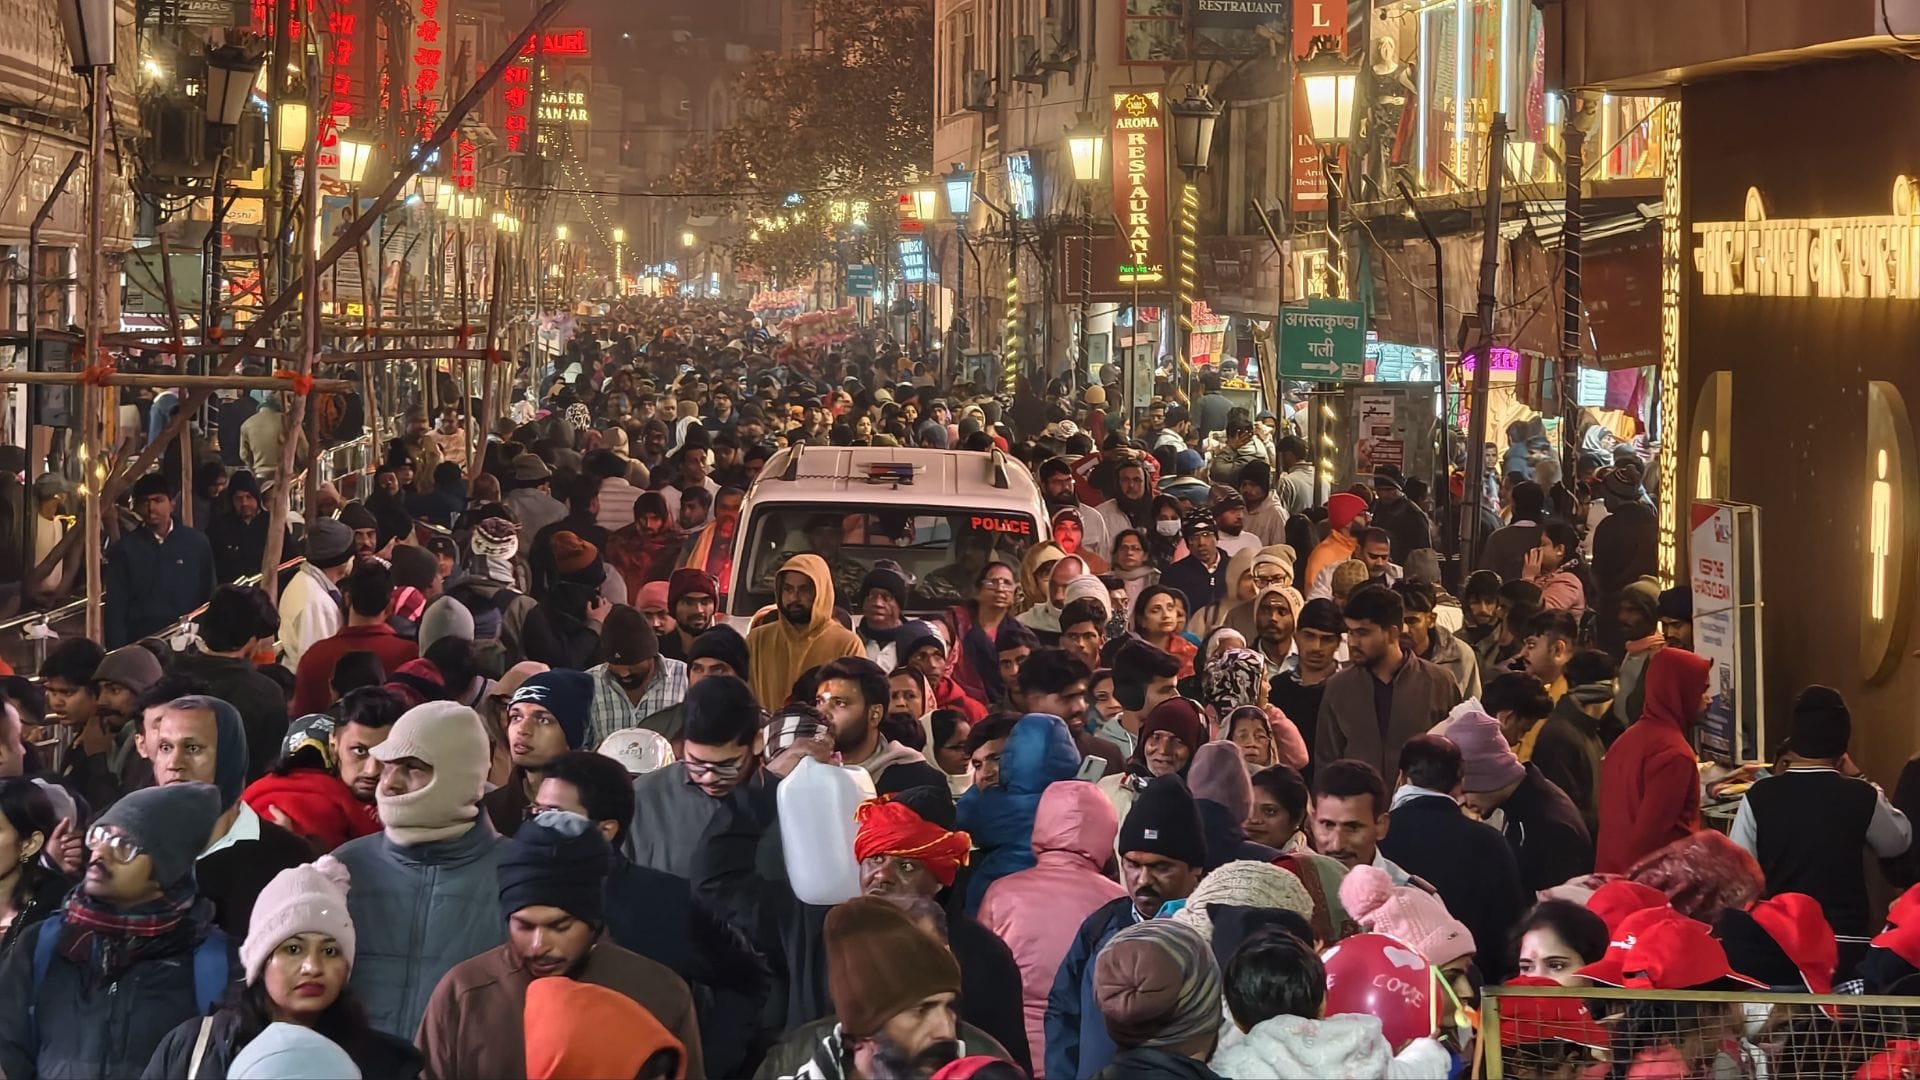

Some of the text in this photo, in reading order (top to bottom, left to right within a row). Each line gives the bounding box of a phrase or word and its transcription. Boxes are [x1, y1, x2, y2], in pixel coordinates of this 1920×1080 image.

[1199, 0, 1282, 14] RESTRAUANT
[1116, 117, 1159, 129] AROMA
[1128, 133, 1150, 265] RESTAURANT
[1285, 312, 1360, 334] अगस्तकुण्डा
[1307, 338, 1335, 357] गली
[971, 517, 1030, 534] POLICE
